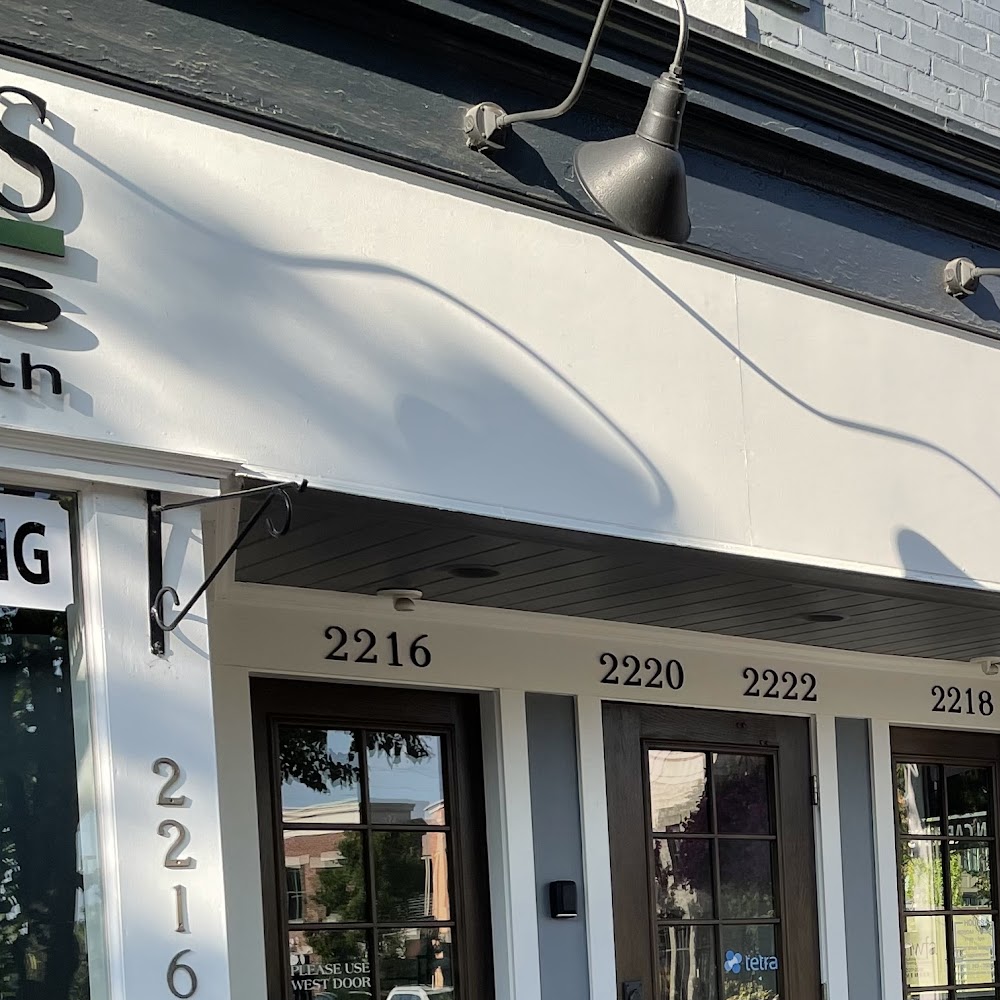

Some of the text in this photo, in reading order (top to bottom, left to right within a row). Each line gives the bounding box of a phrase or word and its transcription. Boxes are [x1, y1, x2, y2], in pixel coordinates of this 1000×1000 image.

[324, 625, 431, 668] 2216
[599, 652, 684, 690] 2220
[742, 667, 817, 701] 2222
[931, 685, 994, 716] 2218
[290, 962, 371, 976] PLEASE USE
[745, 954, 778, 971] tetra
[291, 976, 371, 990] WEST DOOR
